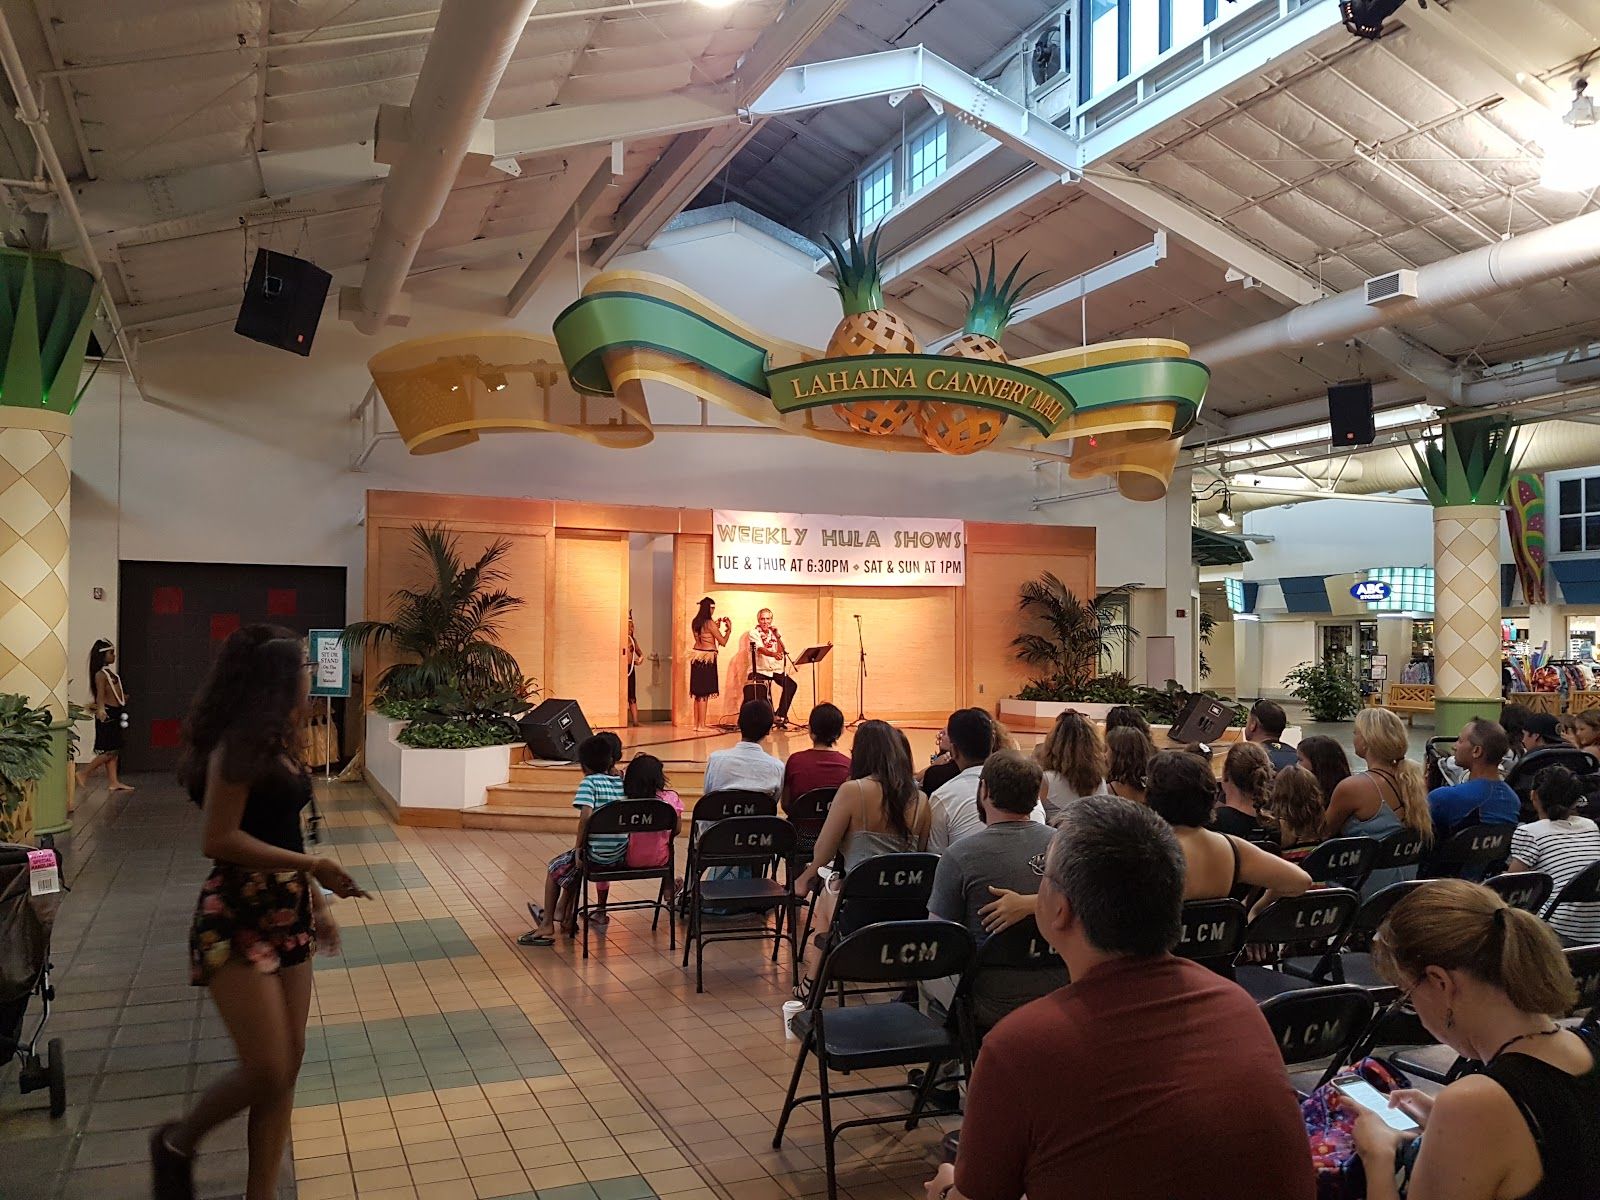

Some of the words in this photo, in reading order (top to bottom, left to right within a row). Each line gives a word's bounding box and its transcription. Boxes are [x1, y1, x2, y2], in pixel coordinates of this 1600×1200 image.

[791, 367, 918, 399] LAHAINA
[926, 368, 1033, 405] CANNERY
[1030, 389, 1065, 425] MALL
[716, 524, 808, 546] WEEKLY
[821, 529, 880, 547] HULA
[893, 530, 961, 549] SHOWS
[716, 555, 739, 570] TUE
[743, 556, 752, 570] &
[757, 557, 786, 572] THUR
[790, 558, 803, 572] AT
[807, 558, 849, 573] 6:30PM
[863, 560, 882, 574] SAT
[886, 560, 894, 574] &
[898, 560, 921, 574] SUN
[924, 560, 936, 574] AT
[940, 560, 961, 574] 1PM
[1356, 583, 1385, 595] ABC
[722, 803, 755, 815] LCM
[618, 813, 653, 826] LCM
[734, 832, 773, 846] LCM
[1472, 836, 1503, 850] LCM
[1393, 841, 1423, 857] LCM
[1328, 850, 1361, 868] LCM
[878, 870, 923, 886] LCM
[1296, 906, 1339, 928] LCM
[1181, 921, 1226, 943] LCM
[881, 941, 938, 965] LCM
[1283, 1018, 1340, 1048] LCM
